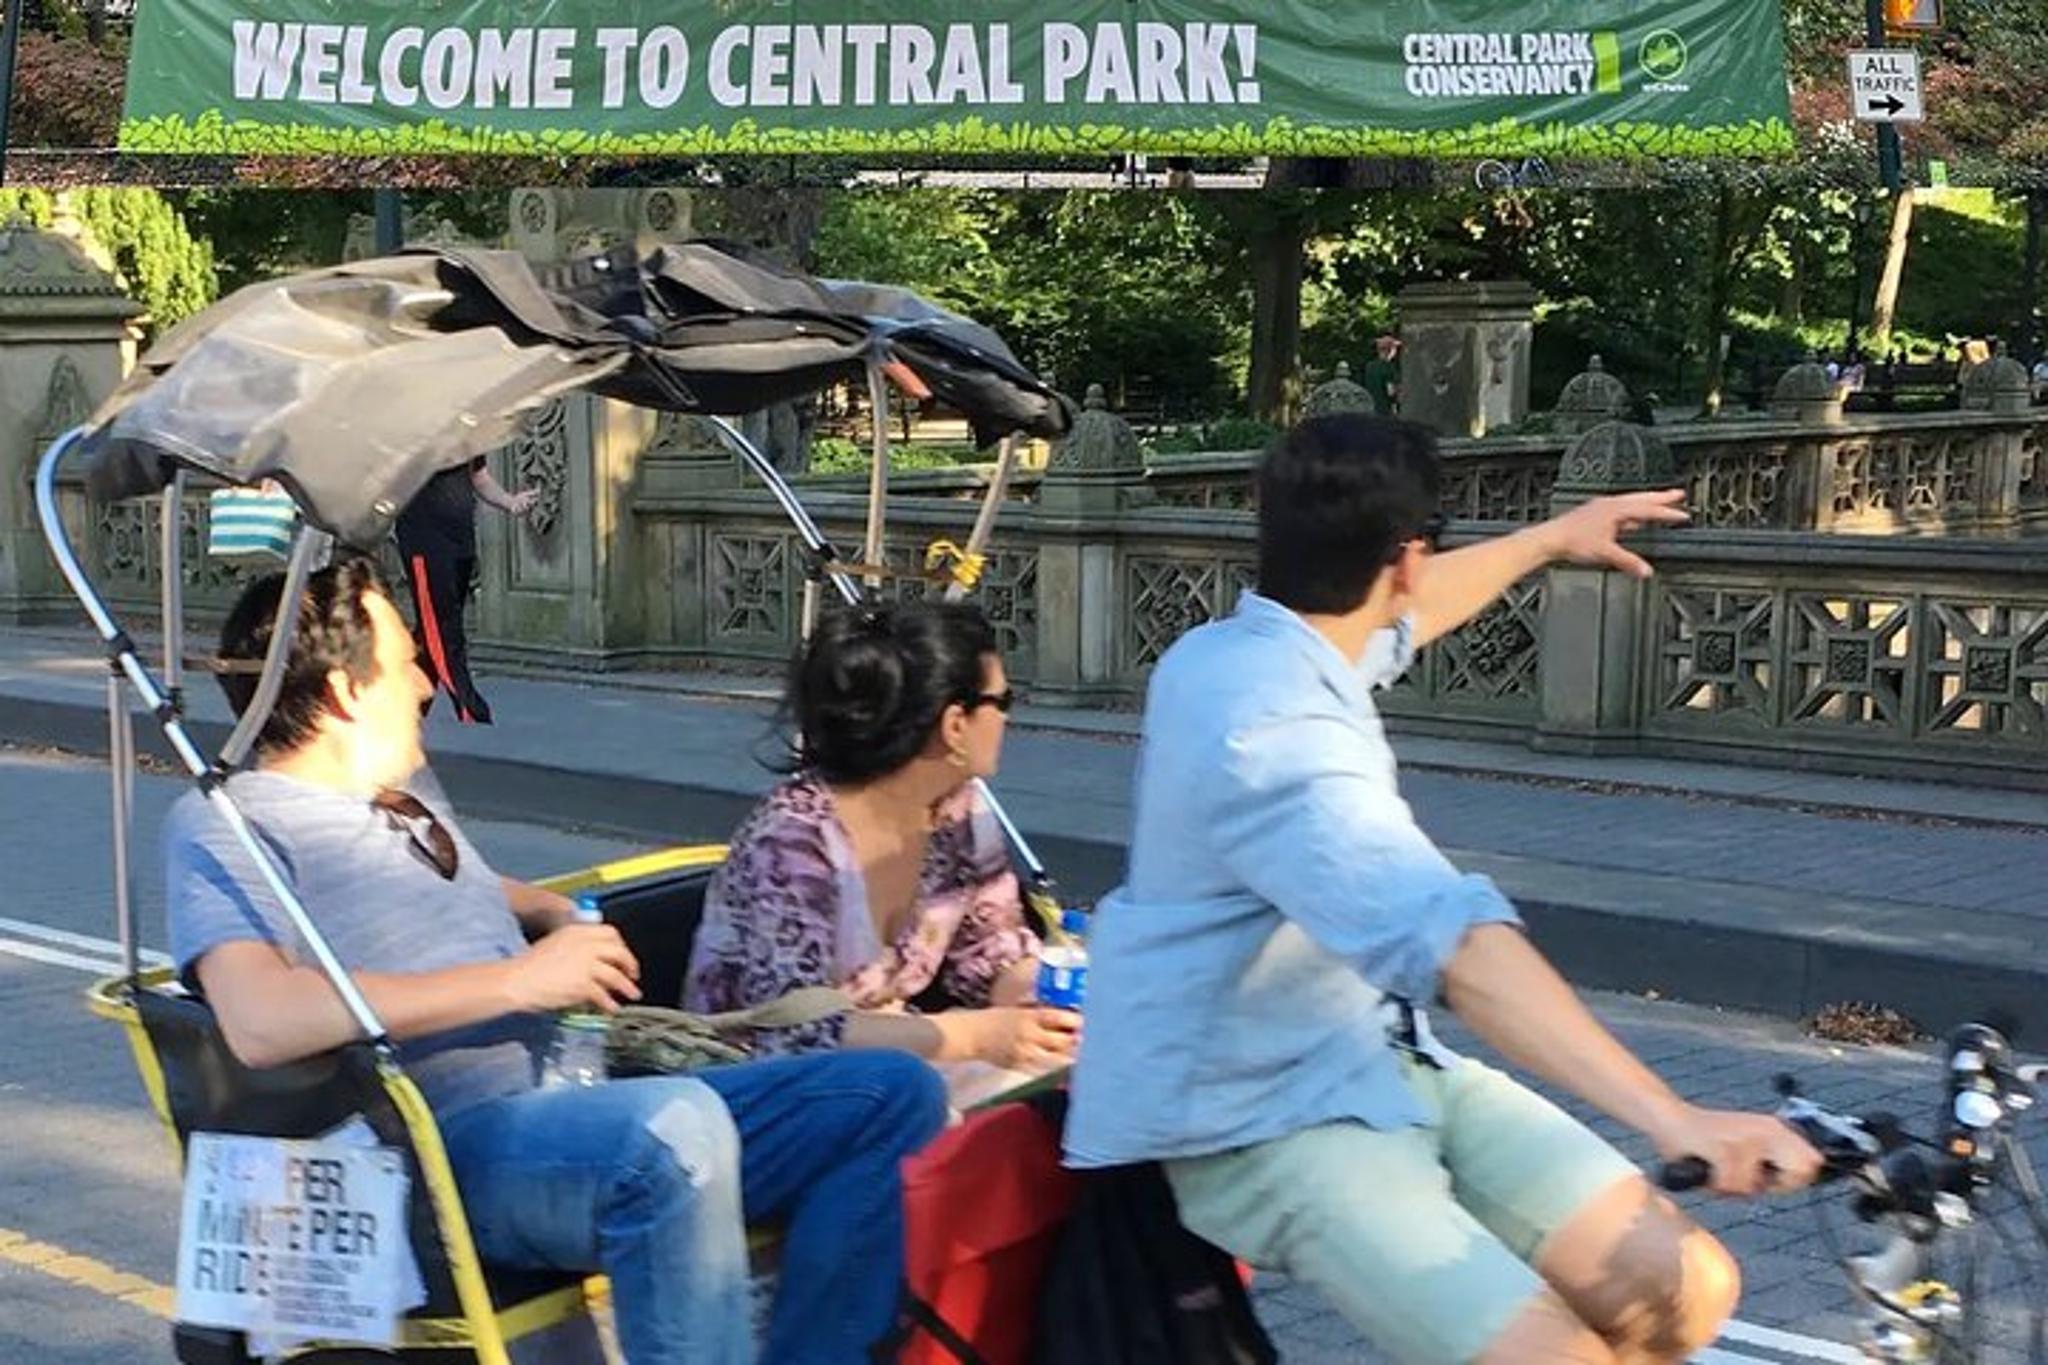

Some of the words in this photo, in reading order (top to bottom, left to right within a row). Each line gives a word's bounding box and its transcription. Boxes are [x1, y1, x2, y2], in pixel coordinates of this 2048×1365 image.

[231, 21, 574, 108] WELCOME
[595, 27, 690, 108] TO
[708, 23, 1025, 107] CENTRAL
[1043, 21, 1258, 104] PARK!
[1404, 33, 1518, 63] CENTRAL
[1521, 32, 1593, 62] PARK
[1865, 56, 1902, 73] ALL
[1405, 65, 1593, 95] CONSERVANCY
[1856, 76, 1915, 91] TRAFFIC
[285, 1157, 345, 1204] PER
[309, 1208, 378, 1256] PER
[194, 1247, 269, 1297] RIDE
